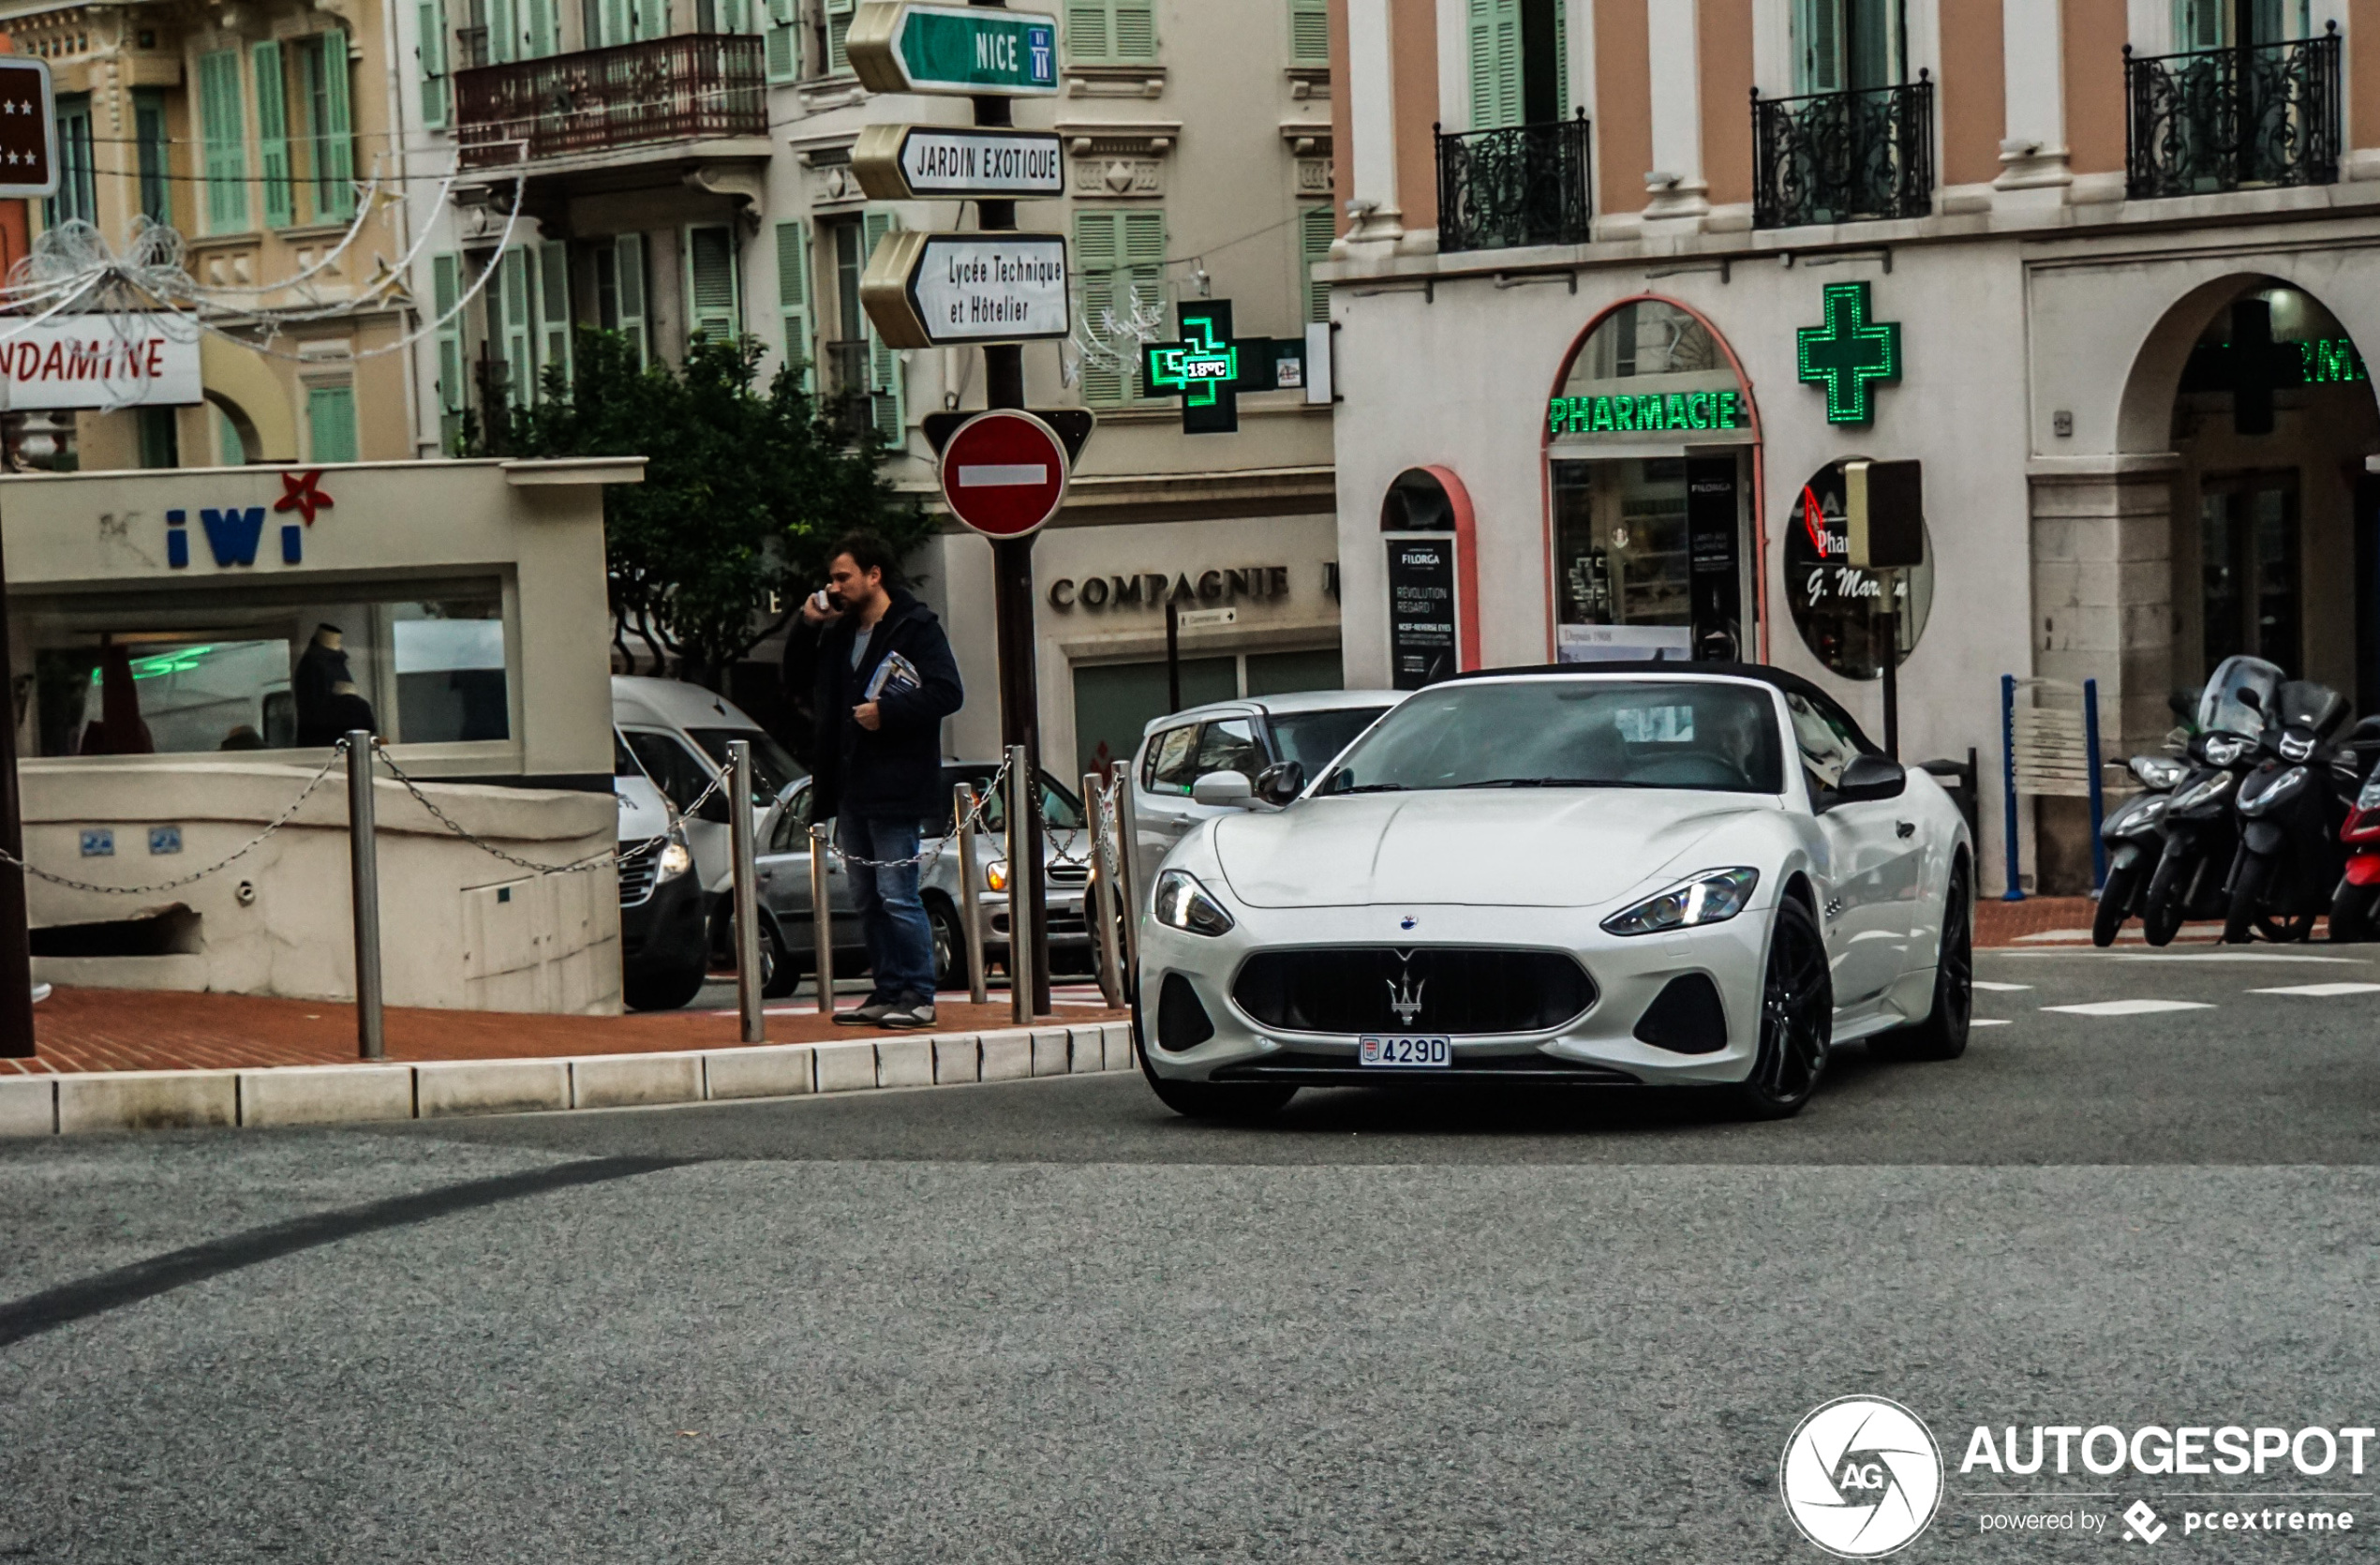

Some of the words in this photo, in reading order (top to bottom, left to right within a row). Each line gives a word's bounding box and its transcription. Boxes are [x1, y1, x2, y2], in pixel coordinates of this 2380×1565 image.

[975, 32, 1019, 72] NICE
[916, 145, 976, 178] JARDIN
[984, 147, 1056, 180] EXOTIQUE
[949, 254, 987, 290] Lycée
[993, 255, 1062, 289] Technique
[950, 299, 963, 324] et
[971, 295, 1029, 323] Hôtelier
[1550, 391, 1736, 433] PHARMACIE
[1402, 554, 1440, 565] FILORGA
[1049, 565, 1288, 608] COMPAGNIE
[1807, 567, 1827, 607] G.
[1383, 1038, 1446, 1063] 429D
